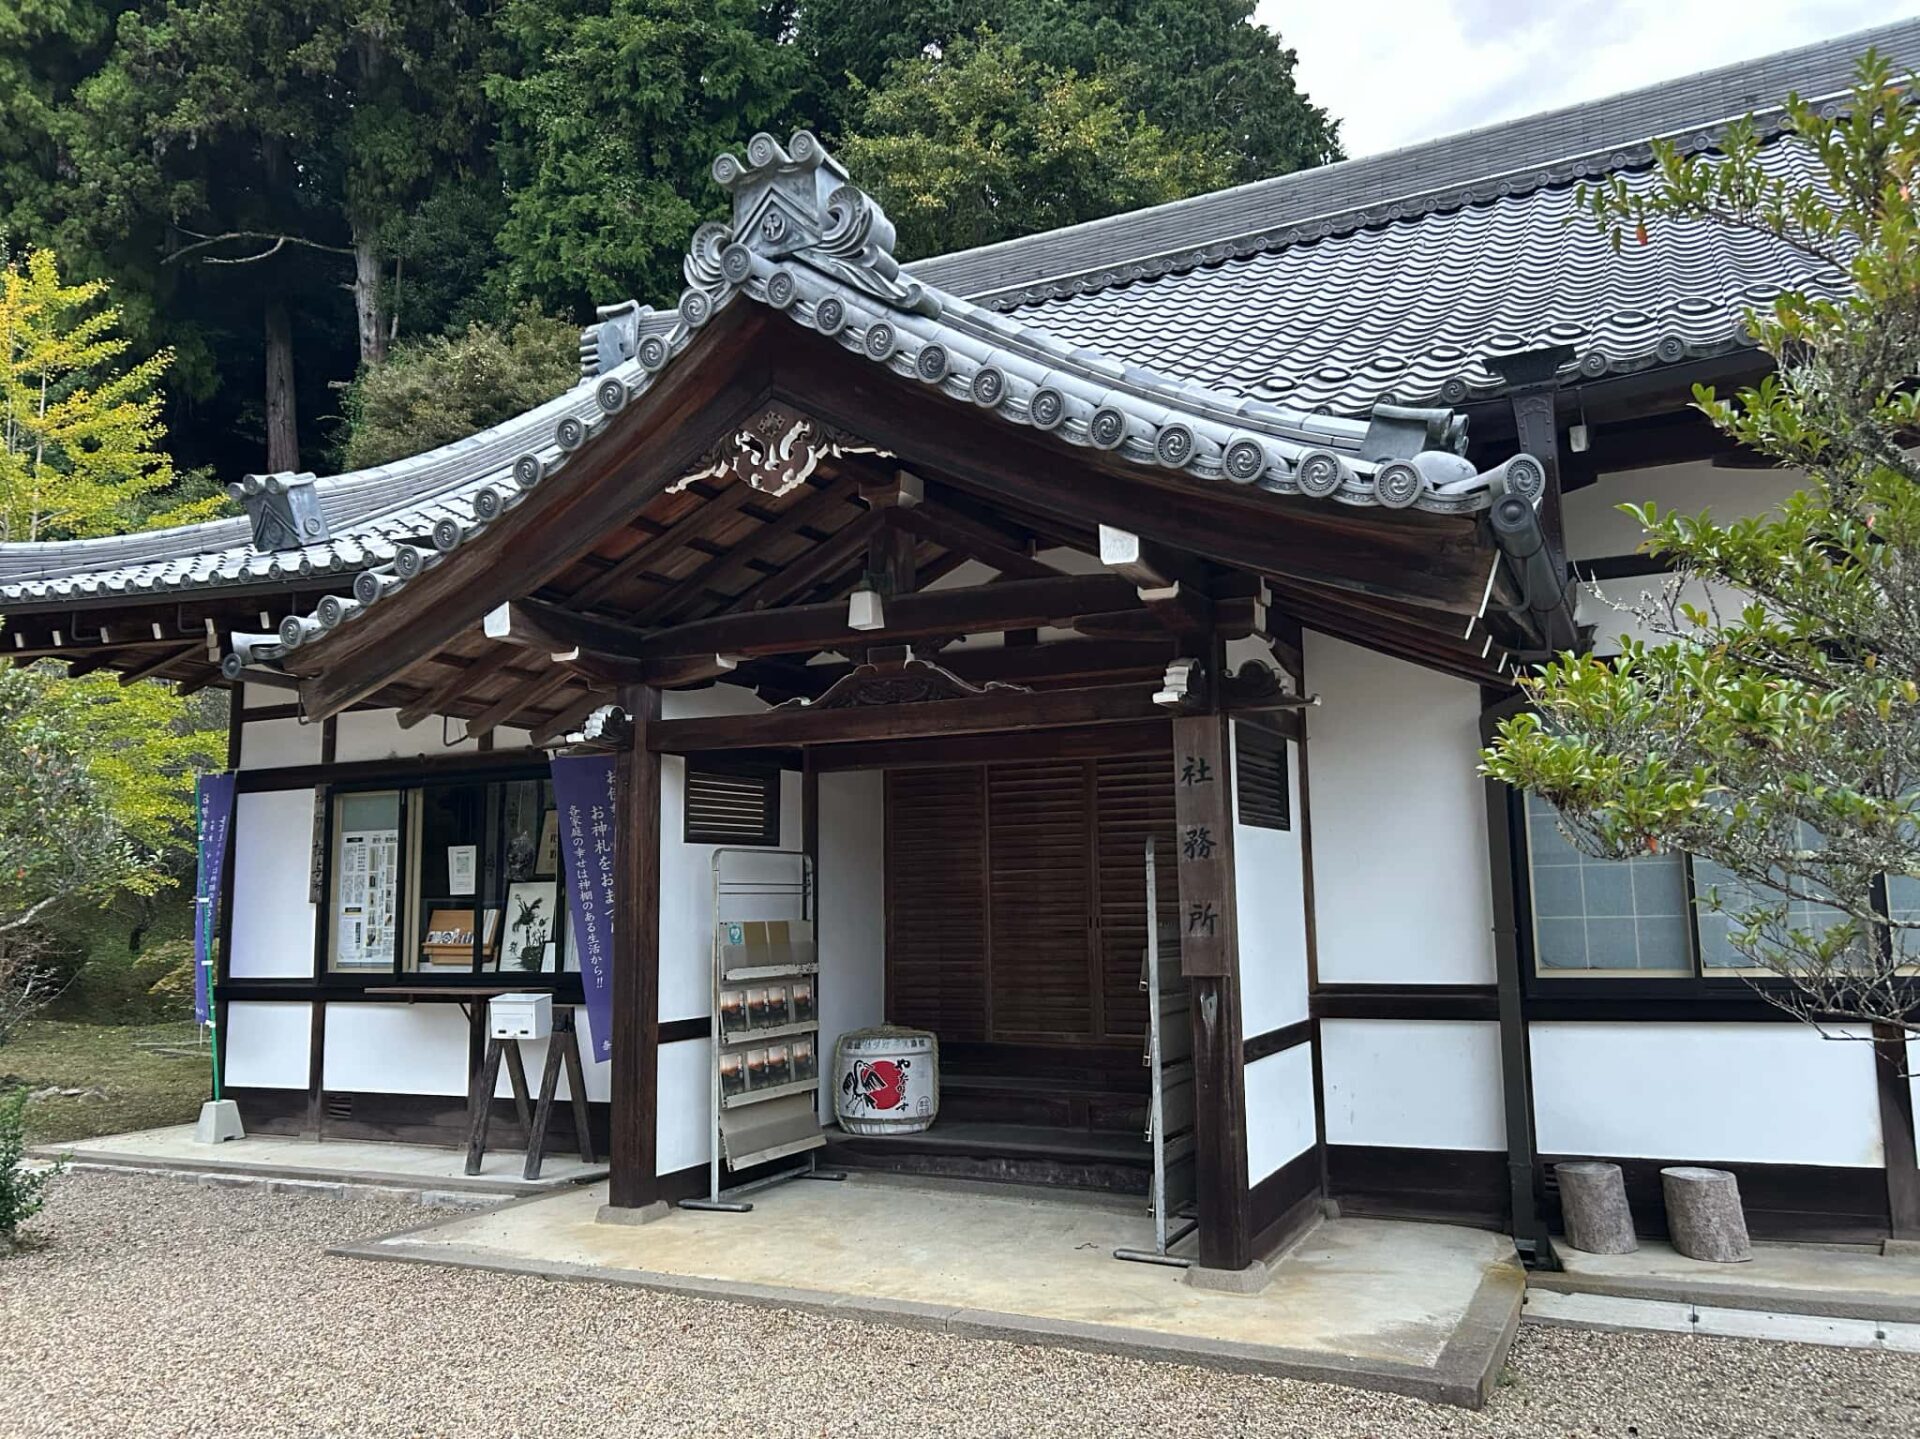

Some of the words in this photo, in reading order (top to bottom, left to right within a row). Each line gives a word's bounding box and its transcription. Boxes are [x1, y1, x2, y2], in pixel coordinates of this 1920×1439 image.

[590, 805, 615, 934] お神札をおまつ
[1181, 757, 1218, 935] 社務所
